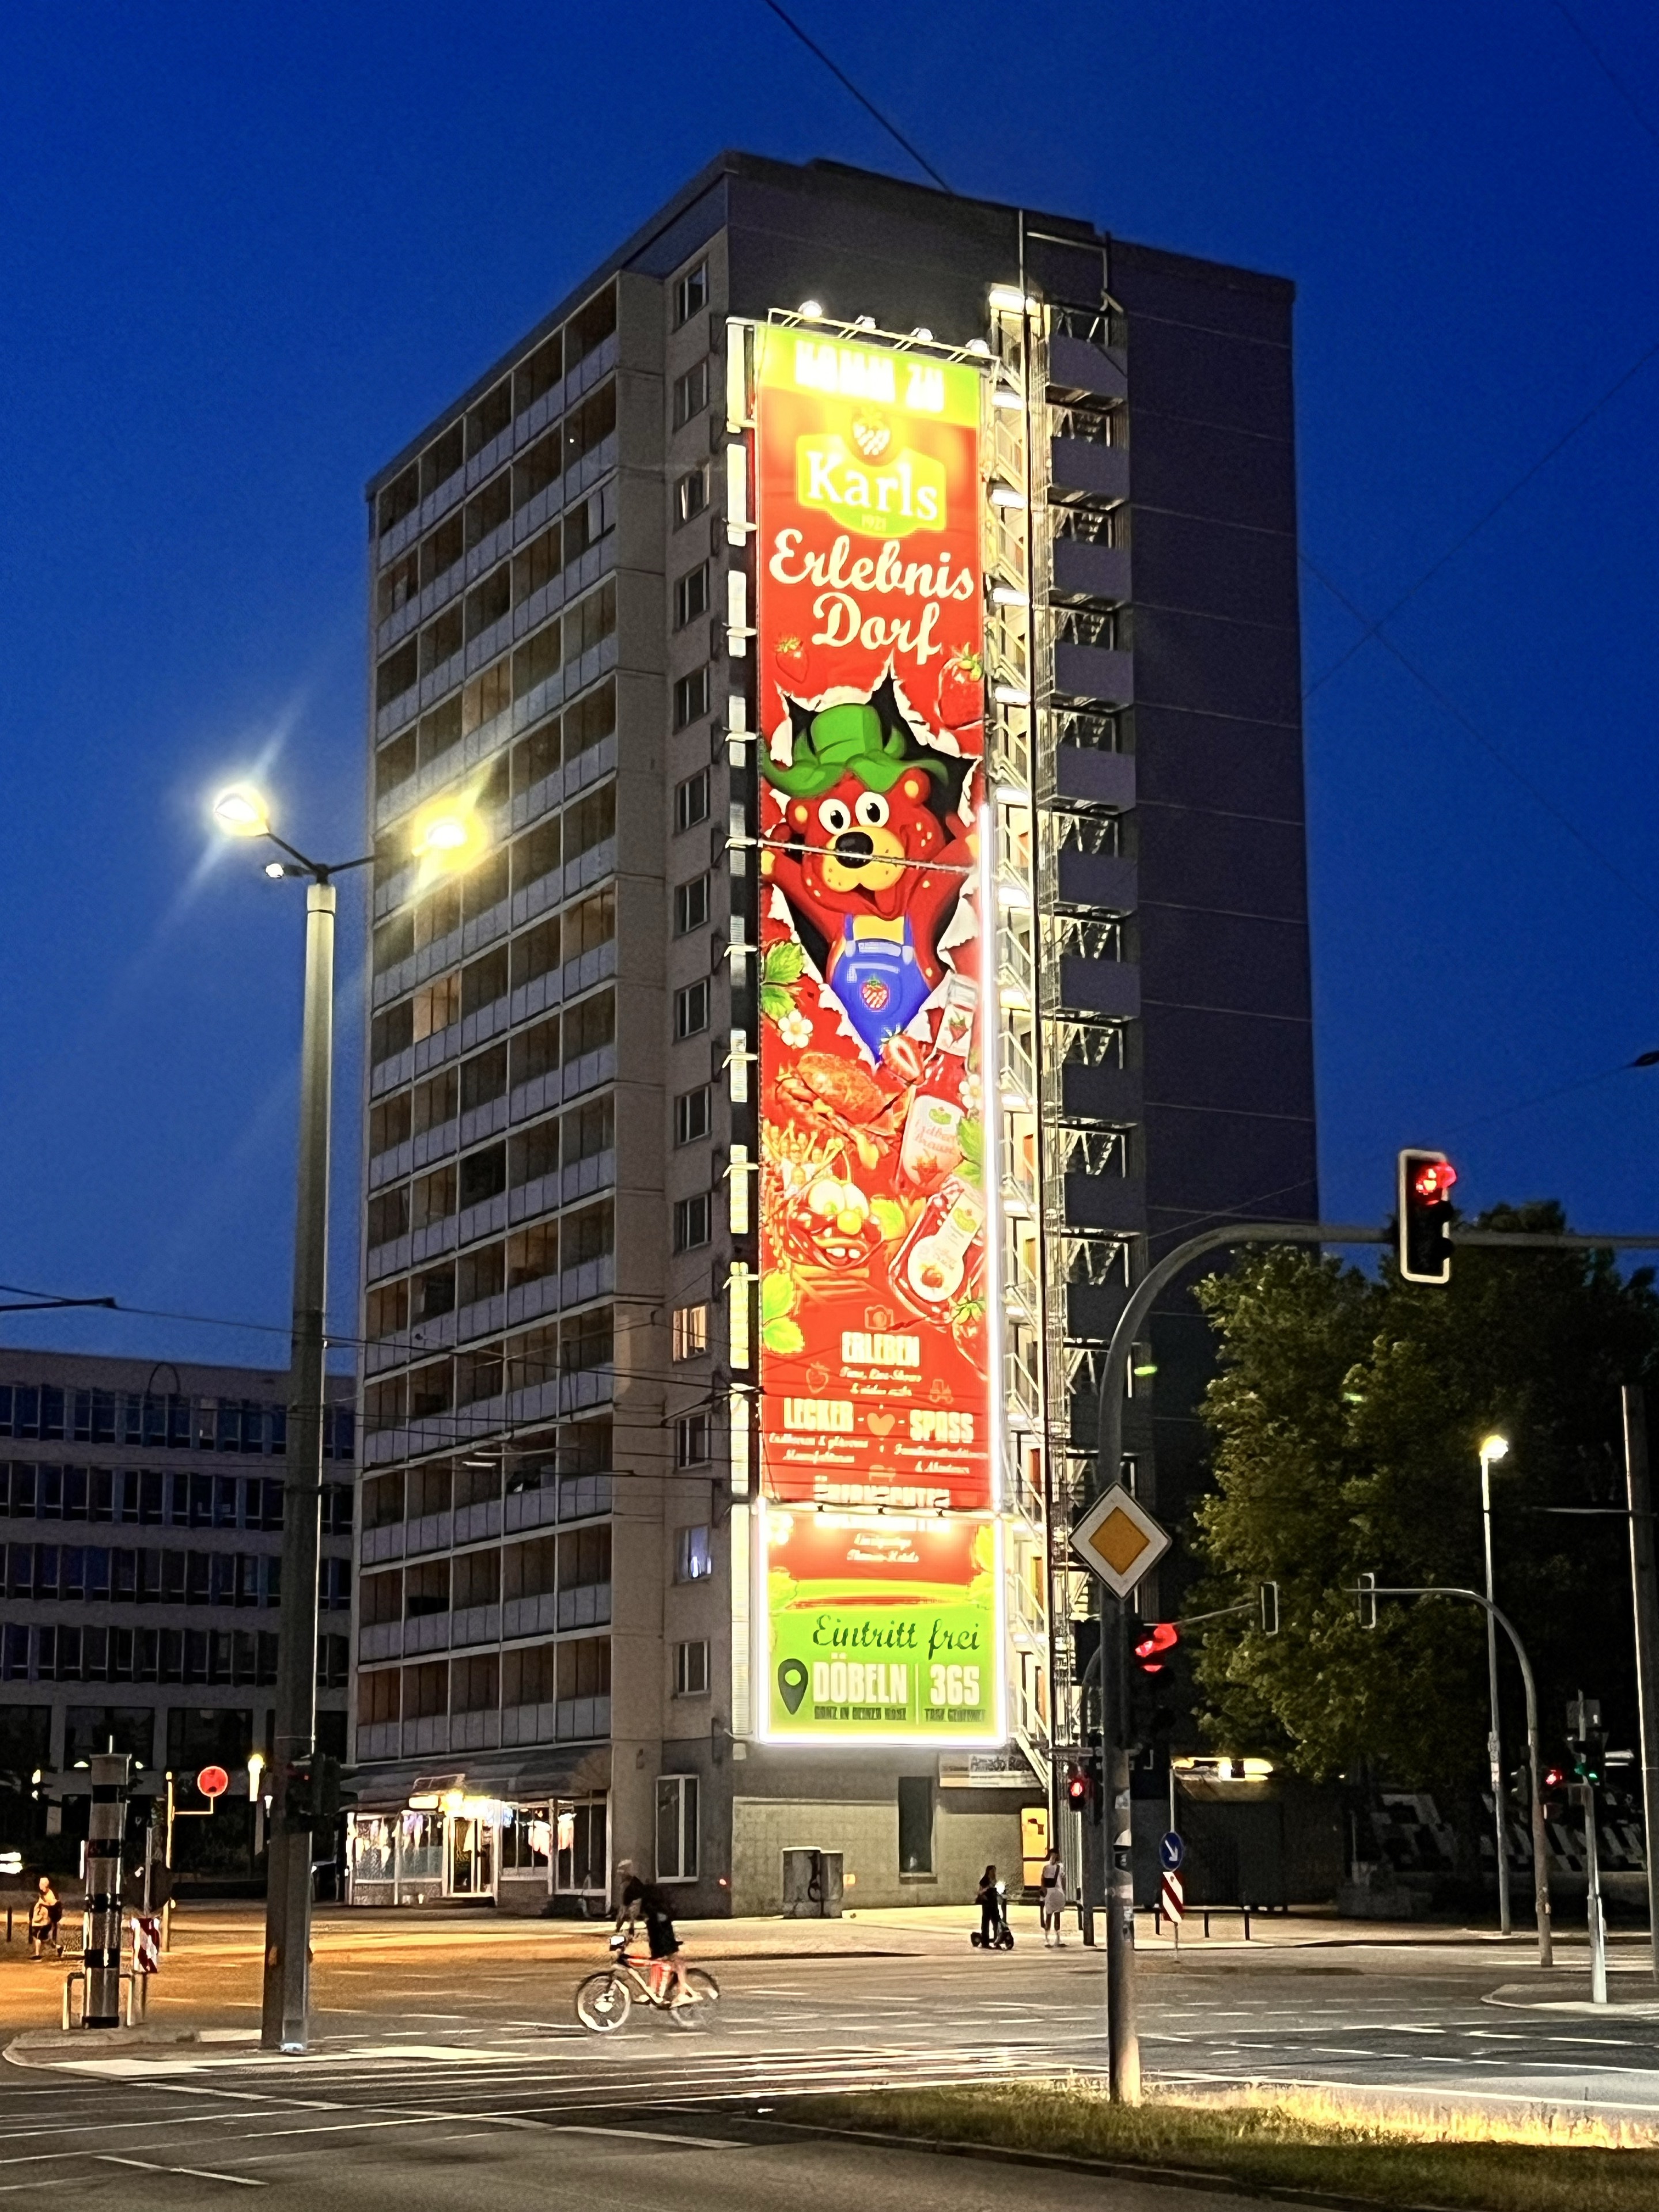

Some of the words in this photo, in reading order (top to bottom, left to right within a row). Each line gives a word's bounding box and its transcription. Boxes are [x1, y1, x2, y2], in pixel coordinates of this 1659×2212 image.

[806, 451, 938, 521] Karls
[769, 528, 974, 601] Erlebnis
[812, 592, 942, 665] Dorf
[783, 1397, 854, 1431] LECKER
[813, 1614, 918, 1649] Eintritt
[927, 1618, 981, 1660] frei
[813, 1652, 907, 1703] DÖBELN
[929, 1664, 980, 1706] 365
